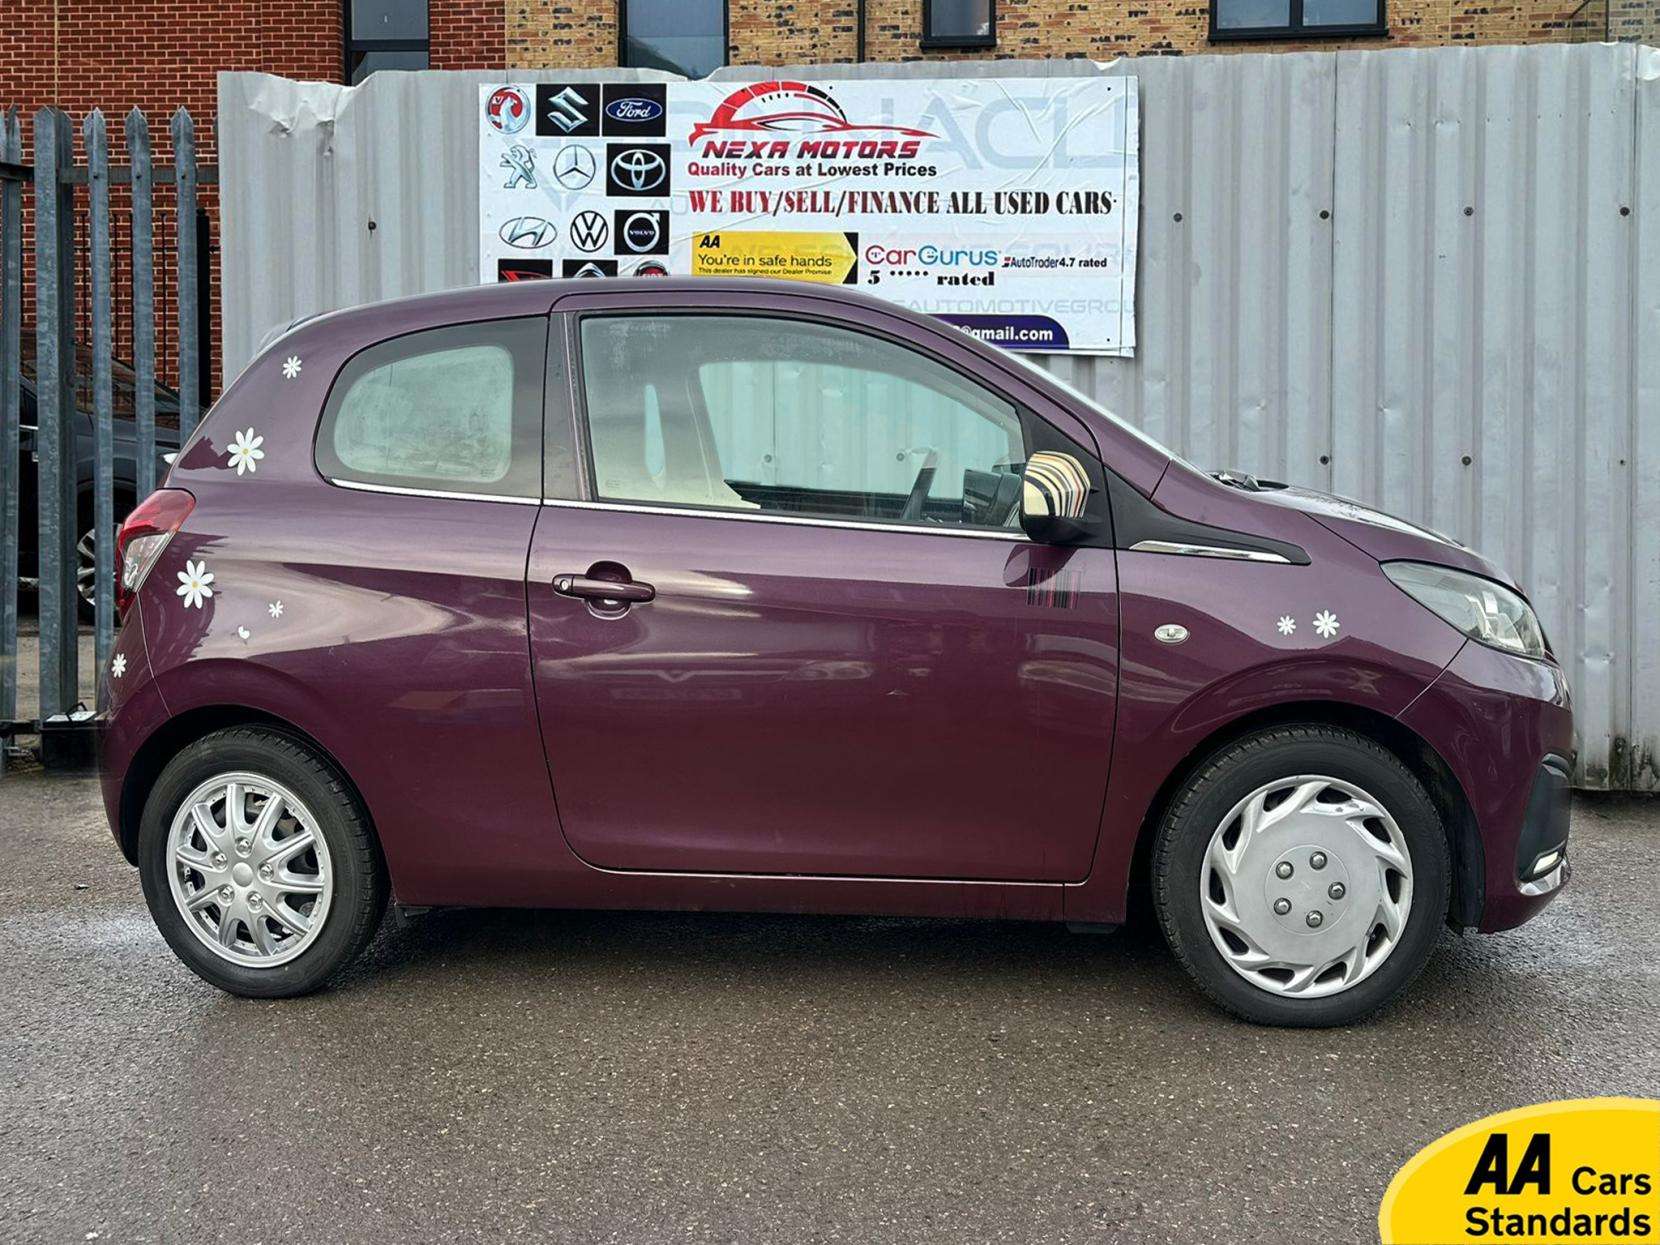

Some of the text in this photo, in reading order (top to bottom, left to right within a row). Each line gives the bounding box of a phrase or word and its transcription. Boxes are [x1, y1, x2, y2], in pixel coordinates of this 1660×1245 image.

[616, 101, 651, 118] Ford
[702, 141, 920, 159] NEXA MOTORS
[688, 162, 937, 178] Quality Cars at Lowest Prices
[688, 190, 723, 213] WE
[946, 191, 987, 214] ALL
[994, 191, 1050, 215] USED
[699, 235, 720, 248] AA
[699, 254, 833, 268] You're in safe hands
[865, 245, 998, 266] CarGurus
[1078, 257, 1107, 268] rated
[749, 268, 769, 276] signed
[868, 270, 995, 286] 5 rated
